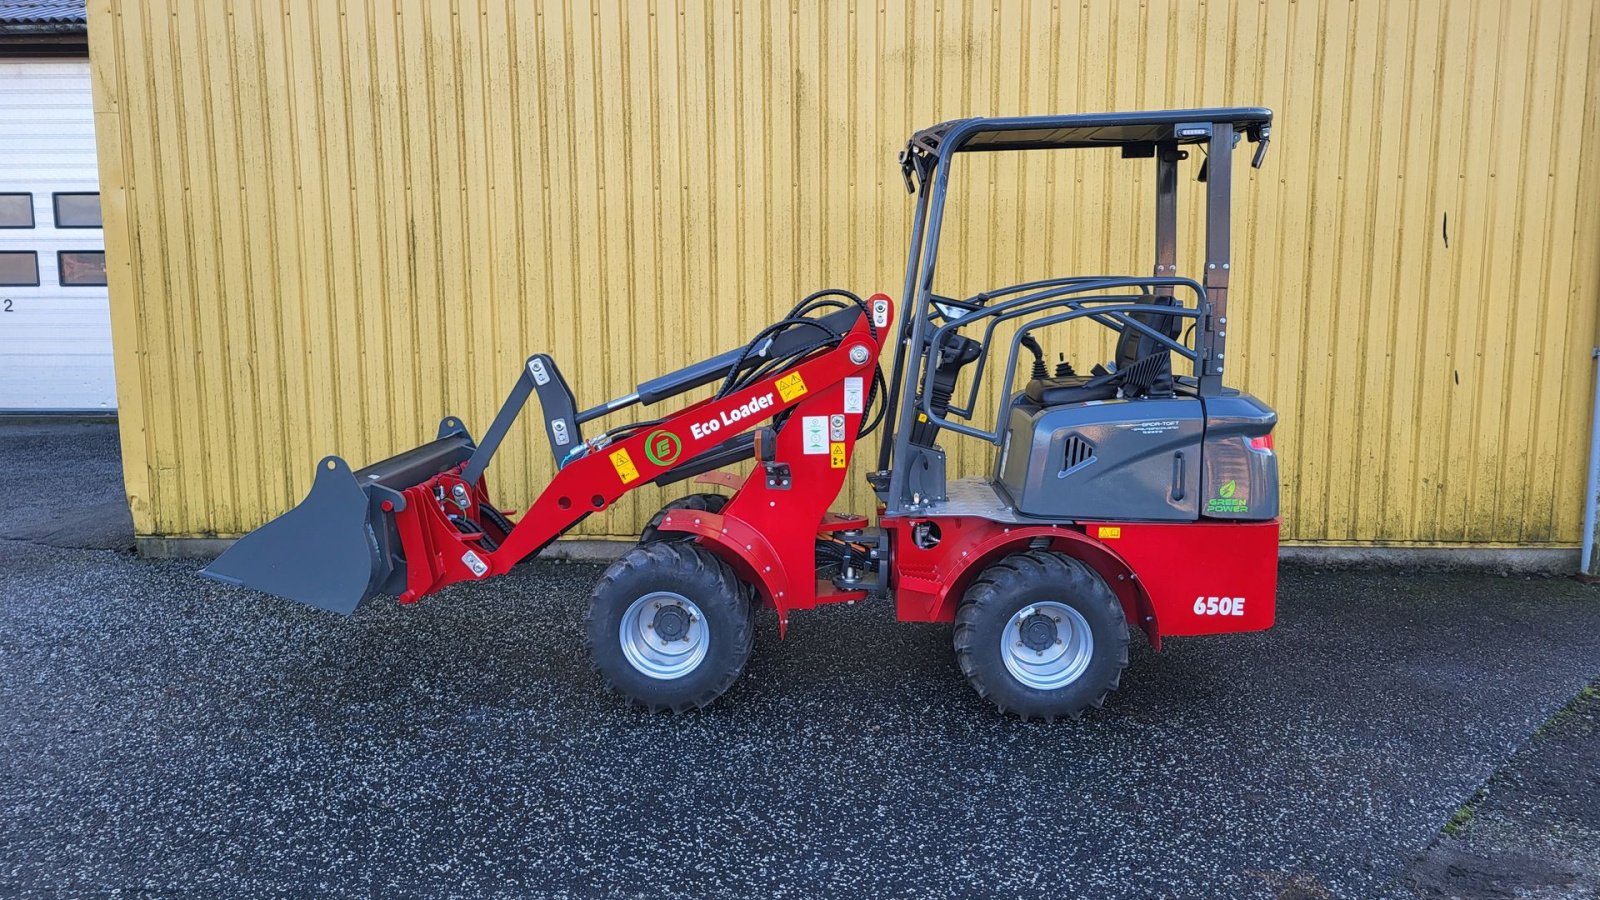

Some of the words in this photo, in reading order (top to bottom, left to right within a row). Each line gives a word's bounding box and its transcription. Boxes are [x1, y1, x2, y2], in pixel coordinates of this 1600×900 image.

[4, 299, 14, 312] 2
[690, 419, 721, 440] Eco
[719, 392, 774, 426] Loader
[1208, 498, 1247, 506] GREEN
[1206, 505, 1249, 513] POWER
[1193, 596, 1246, 616] 650E
